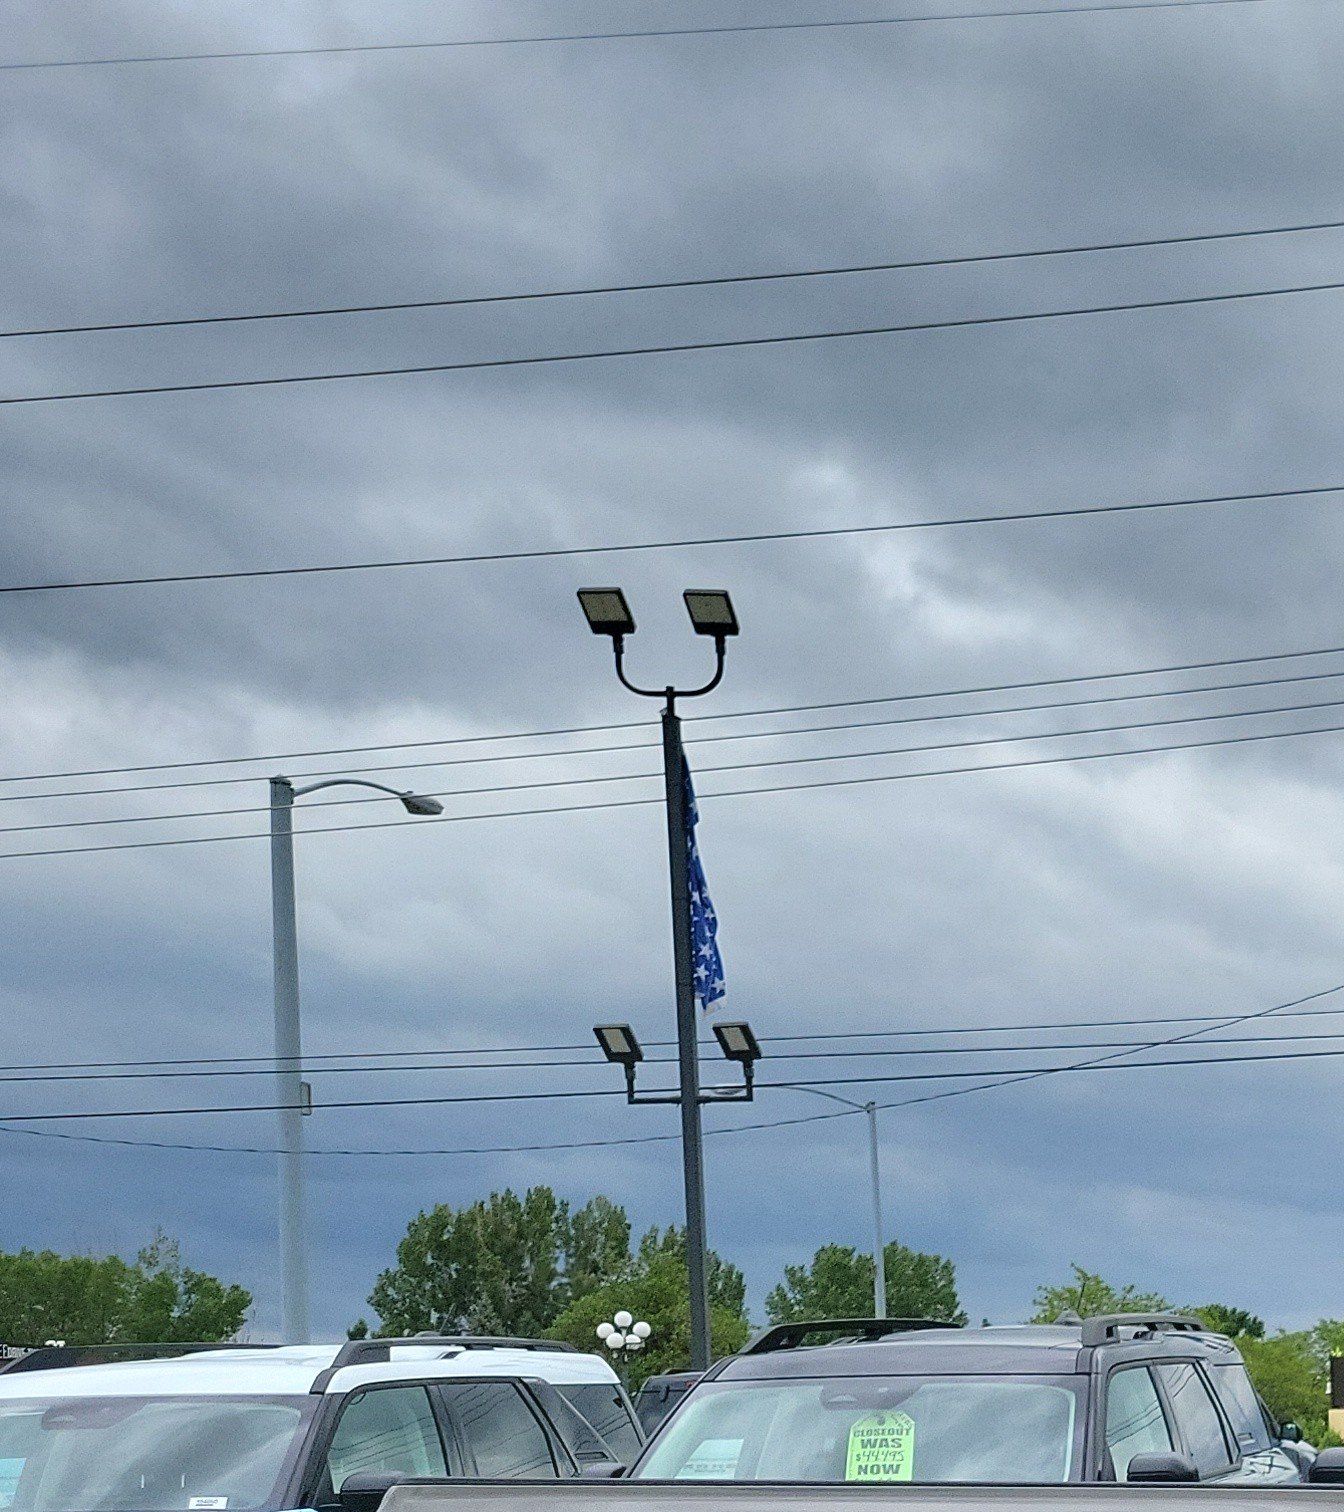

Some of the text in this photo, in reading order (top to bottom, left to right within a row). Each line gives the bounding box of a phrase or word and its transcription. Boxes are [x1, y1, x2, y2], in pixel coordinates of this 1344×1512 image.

[853, 1427, 911, 1438] CLOSEOUT
[861, 1437, 903, 1449] WAS
[857, 1463, 901, 1476] NOW
